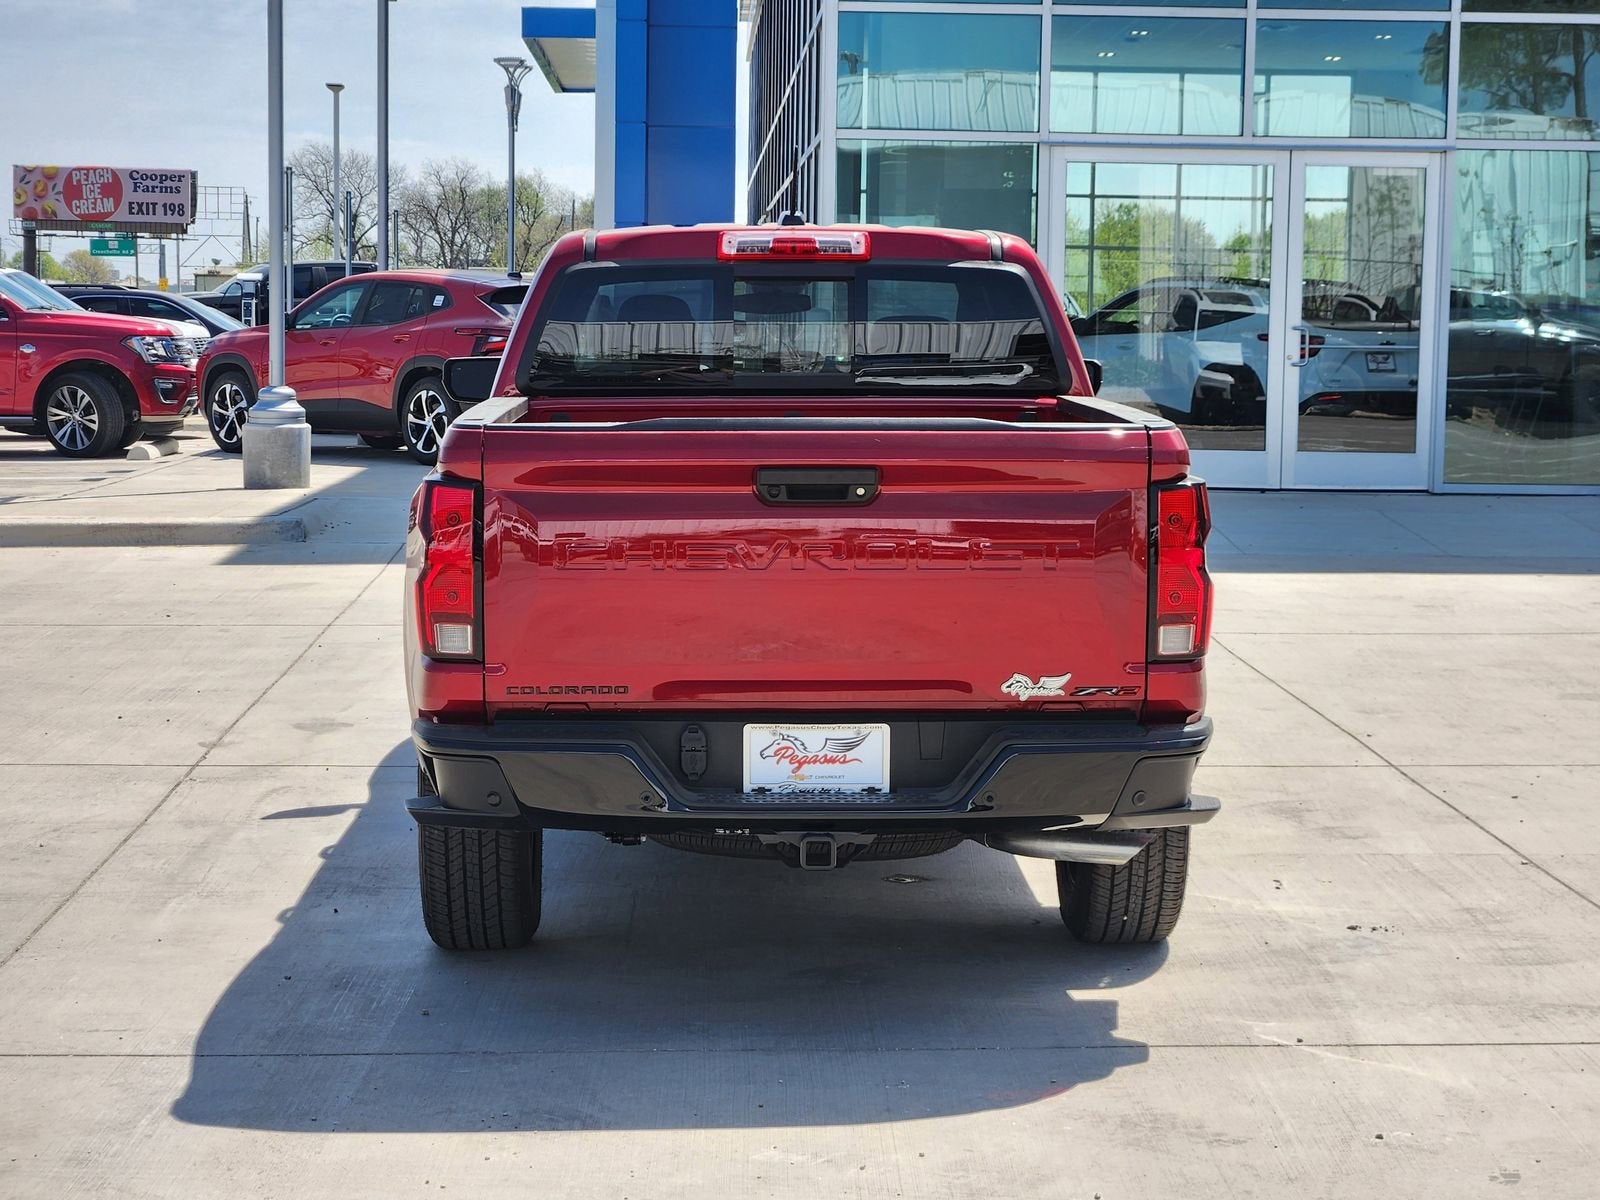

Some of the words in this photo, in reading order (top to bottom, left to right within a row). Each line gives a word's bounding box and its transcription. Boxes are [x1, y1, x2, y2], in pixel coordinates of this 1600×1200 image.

[72, 168, 112, 185] PEACH
[129, 170, 185, 183] Cooper
[82, 184, 101, 198] ICE
[132, 182, 181, 194] Farms
[72, 198, 114, 215] CREAM
[128, 202, 158, 216] EXIT
[162, 203, 185, 217] 198
[552, 538, 1081, 571] CHEVROLET
[506, 686, 629, 695] COLORADO
[1069, 686, 1141, 696] ZR2
[773, 746, 863, 774] Pegasus
